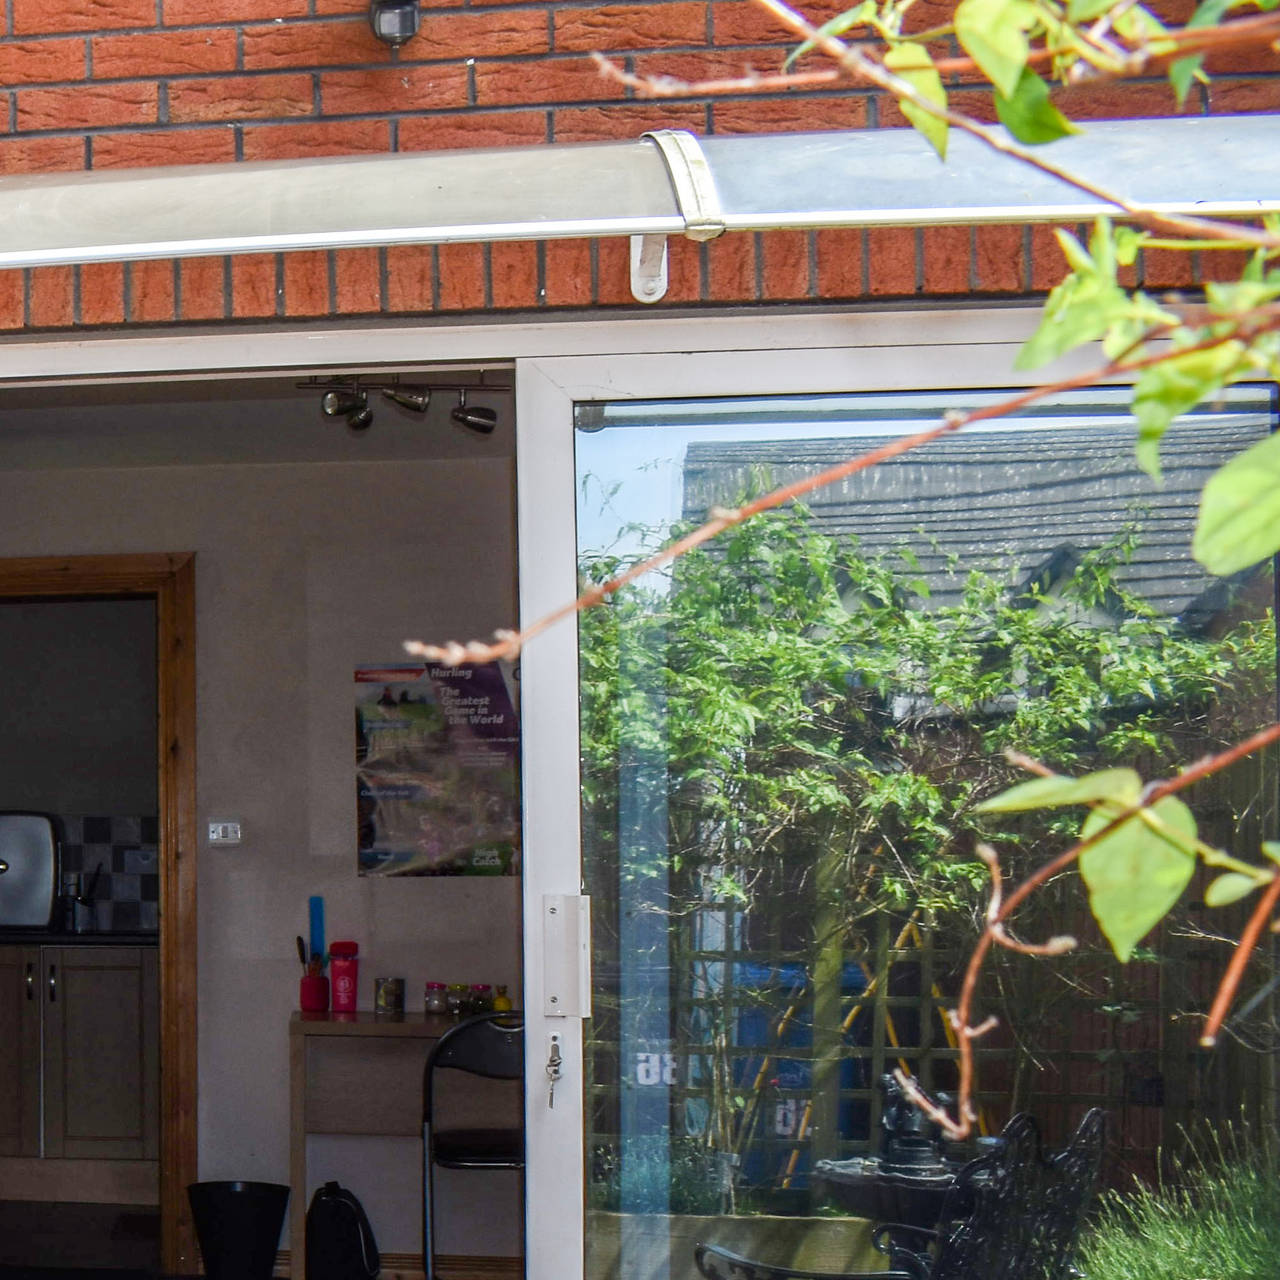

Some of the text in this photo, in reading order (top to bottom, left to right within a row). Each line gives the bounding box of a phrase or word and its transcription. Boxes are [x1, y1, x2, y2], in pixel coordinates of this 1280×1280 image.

[432, 667, 473, 680] Hurling
[439, 687, 460, 697] The
[441, 696, 490, 706] Greatest
[444, 706, 489, 715] Game in
[448, 713, 504, 725] the World
